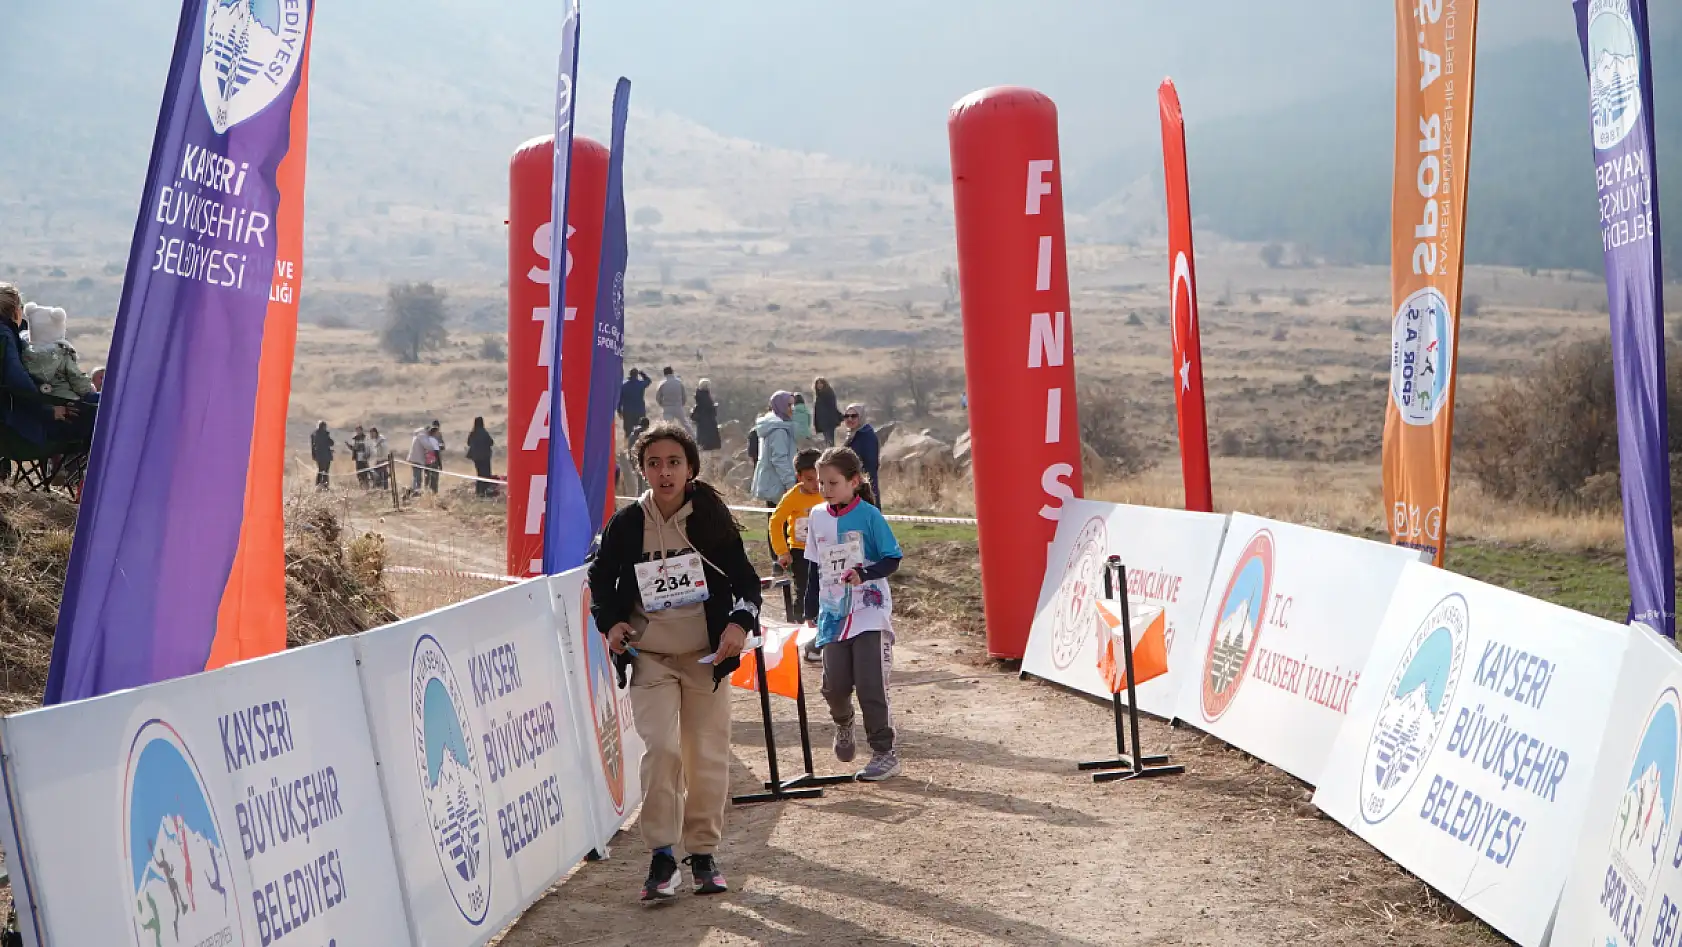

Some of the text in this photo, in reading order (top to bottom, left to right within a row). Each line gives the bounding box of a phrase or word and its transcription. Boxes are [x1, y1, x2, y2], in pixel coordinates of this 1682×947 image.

[277, 259, 294, 280] VE
[1025, 159, 1075, 560] FINIS
[654, 573, 691, 593] 234
[831, 558, 846, 571] 77
[467, 641, 523, 708] KAYSERİ
[1252, 647, 1309, 694] KAYSERİ
[1472, 639, 1557, 710] KAYSERİ
[217, 698, 294, 774] KAYSERİ
[482, 700, 559, 784] BÜYÜKŞEHİR
[1446, 703, 1570, 803] BÜYÜKŞEHİR
[235, 765, 343, 861] BÜYÜKŞEHİR
[497, 773, 564, 860] BELEDİYESİ
[1420, 773, 1527, 869] BELEDİYESİ
[252, 848, 347, 947] BELEDİYESİ
